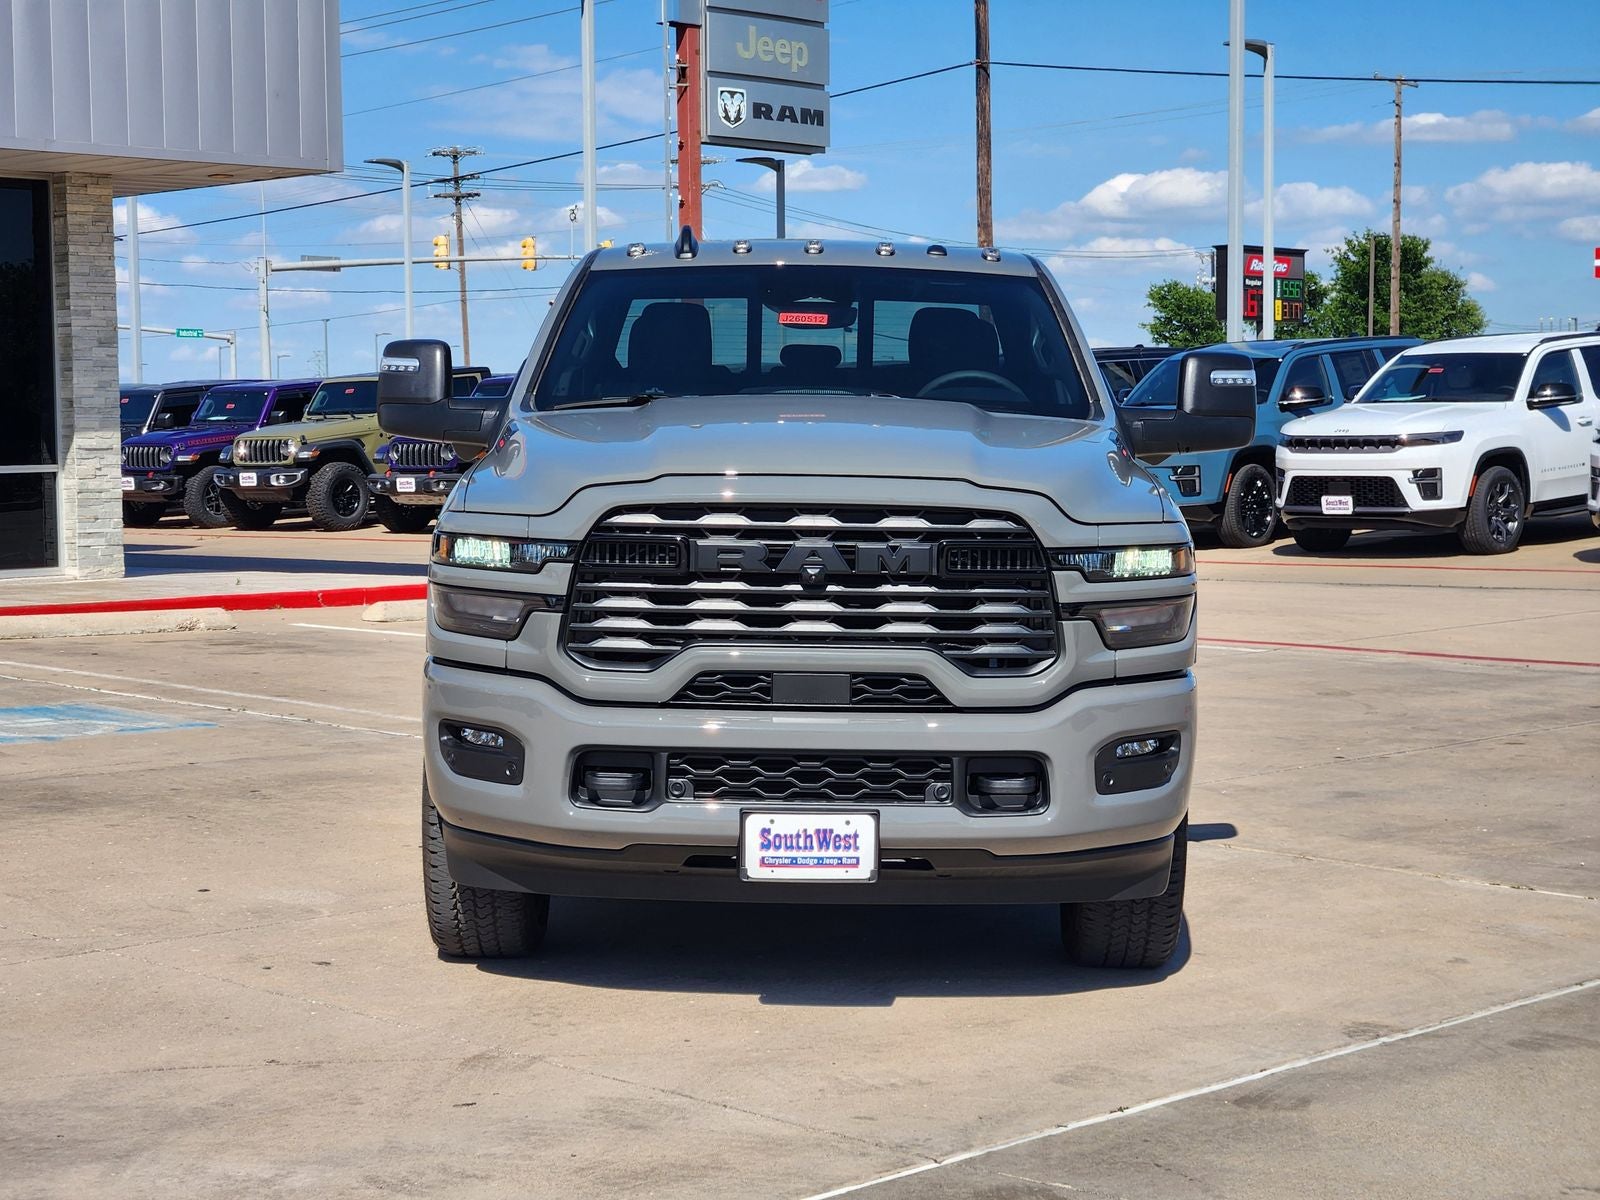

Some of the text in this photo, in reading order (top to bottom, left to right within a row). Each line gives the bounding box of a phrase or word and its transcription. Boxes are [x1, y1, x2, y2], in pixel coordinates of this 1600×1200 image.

[736, 25, 809, 72] Jeep
[752, 102, 824, 127] RAM
[782, 315, 825, 323] J260512
[696, 540, 932, 574] RAM
[760, 827, 860, 852] SouthWest
[764, 857, 857, 865] Chrysler Dodge Jeep Ram
